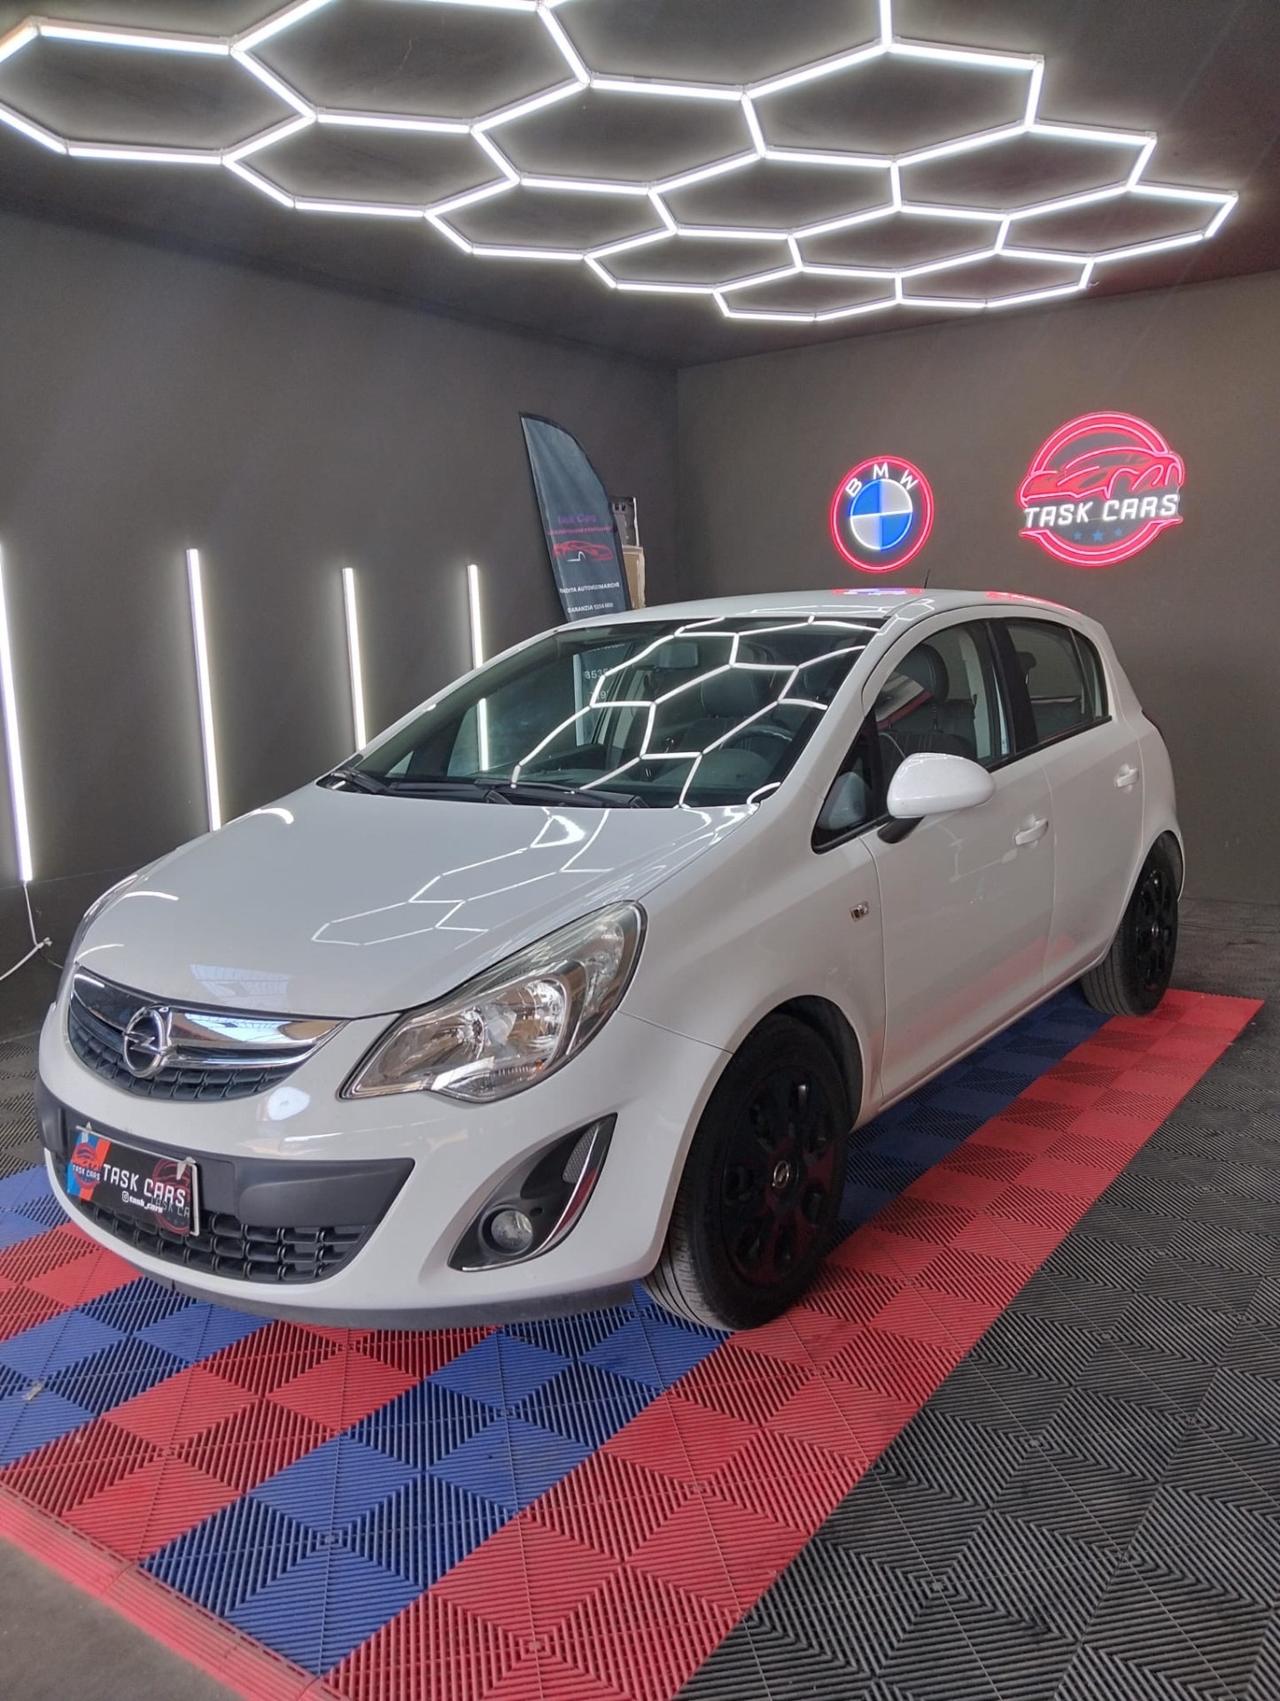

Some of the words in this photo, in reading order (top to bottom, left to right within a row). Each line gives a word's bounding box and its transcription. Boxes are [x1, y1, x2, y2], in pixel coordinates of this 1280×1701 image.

[845, 462, 919, 497] BMW
[1024, 501, 1094, 528] TASK
[1102, 494, 1180, 521] CARS
[72, 1164, 85, 1175] TASK
[103, 1163, 139, 1192] TASK
[143, 1177, 186, 1207] CARS
